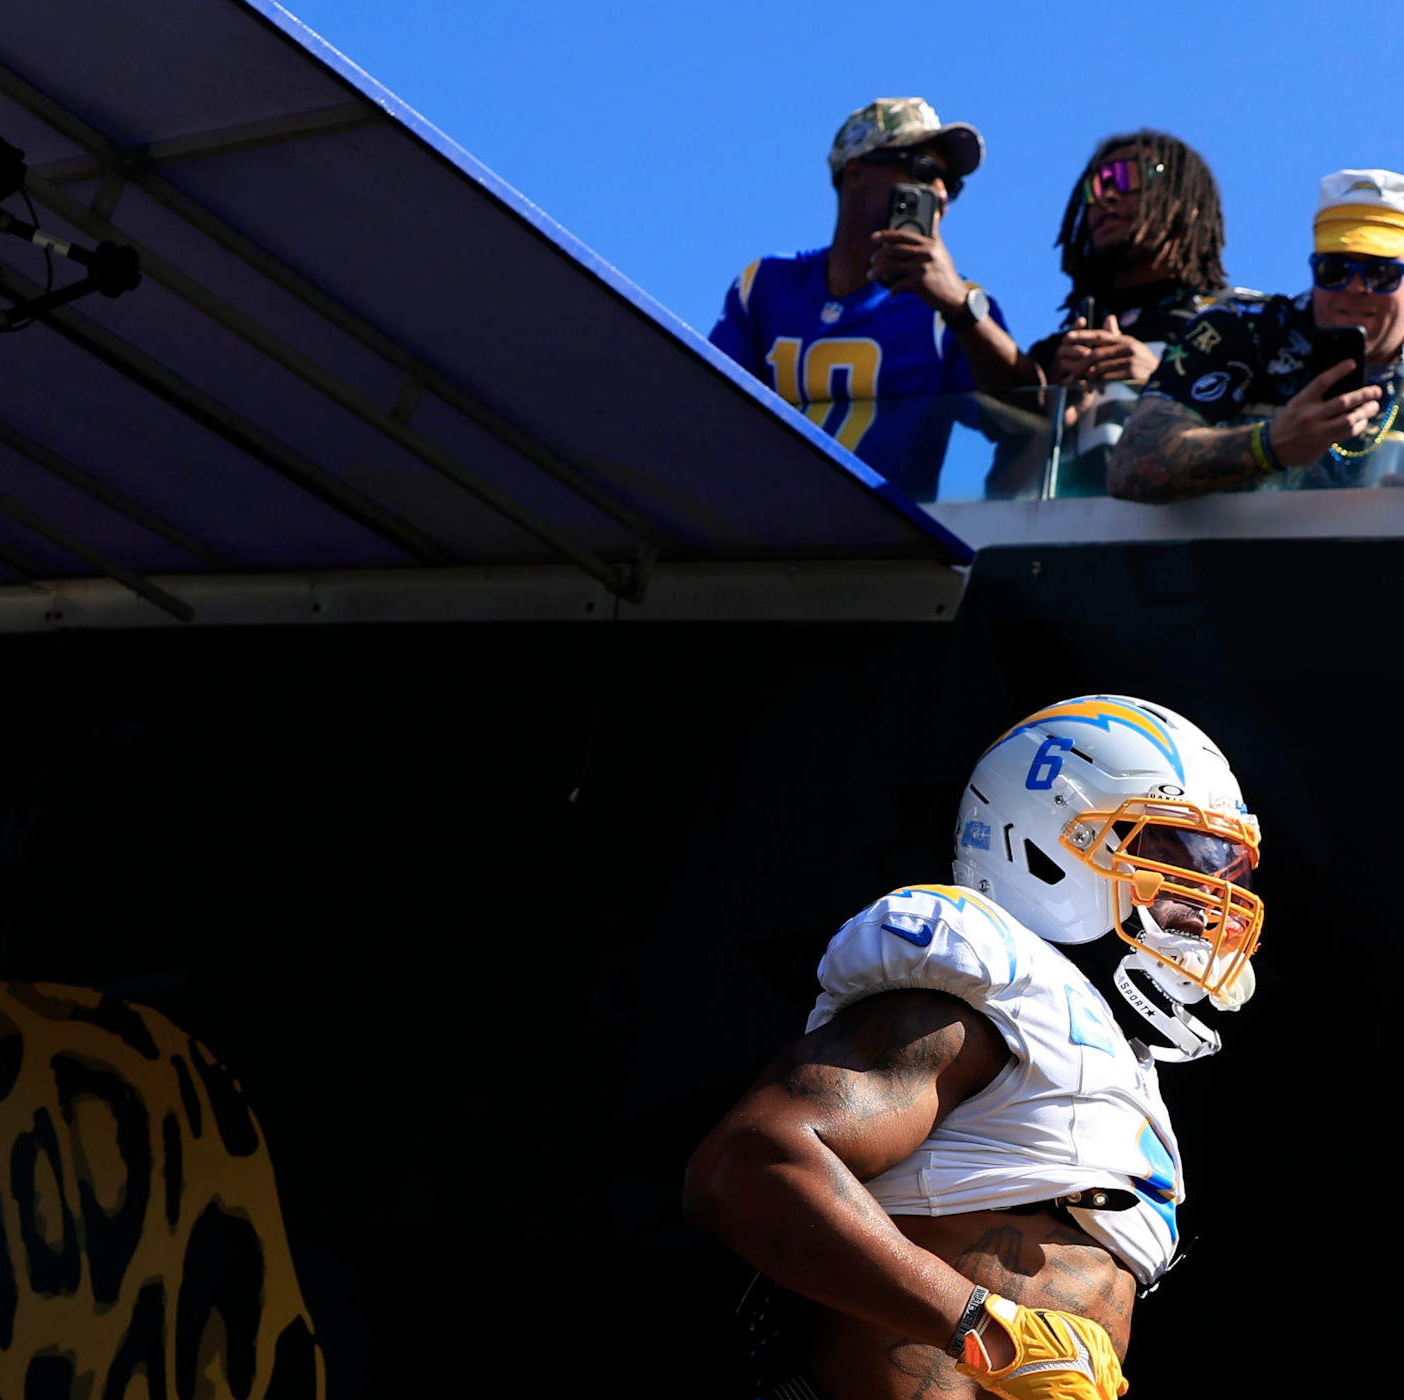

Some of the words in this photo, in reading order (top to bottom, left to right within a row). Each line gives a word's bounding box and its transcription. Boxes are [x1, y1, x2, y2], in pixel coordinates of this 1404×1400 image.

[765, 336, 883, 452] 10
[1025, 737, 1074, 791] 6
[1120, 982, 1150, 1011] SPORT
